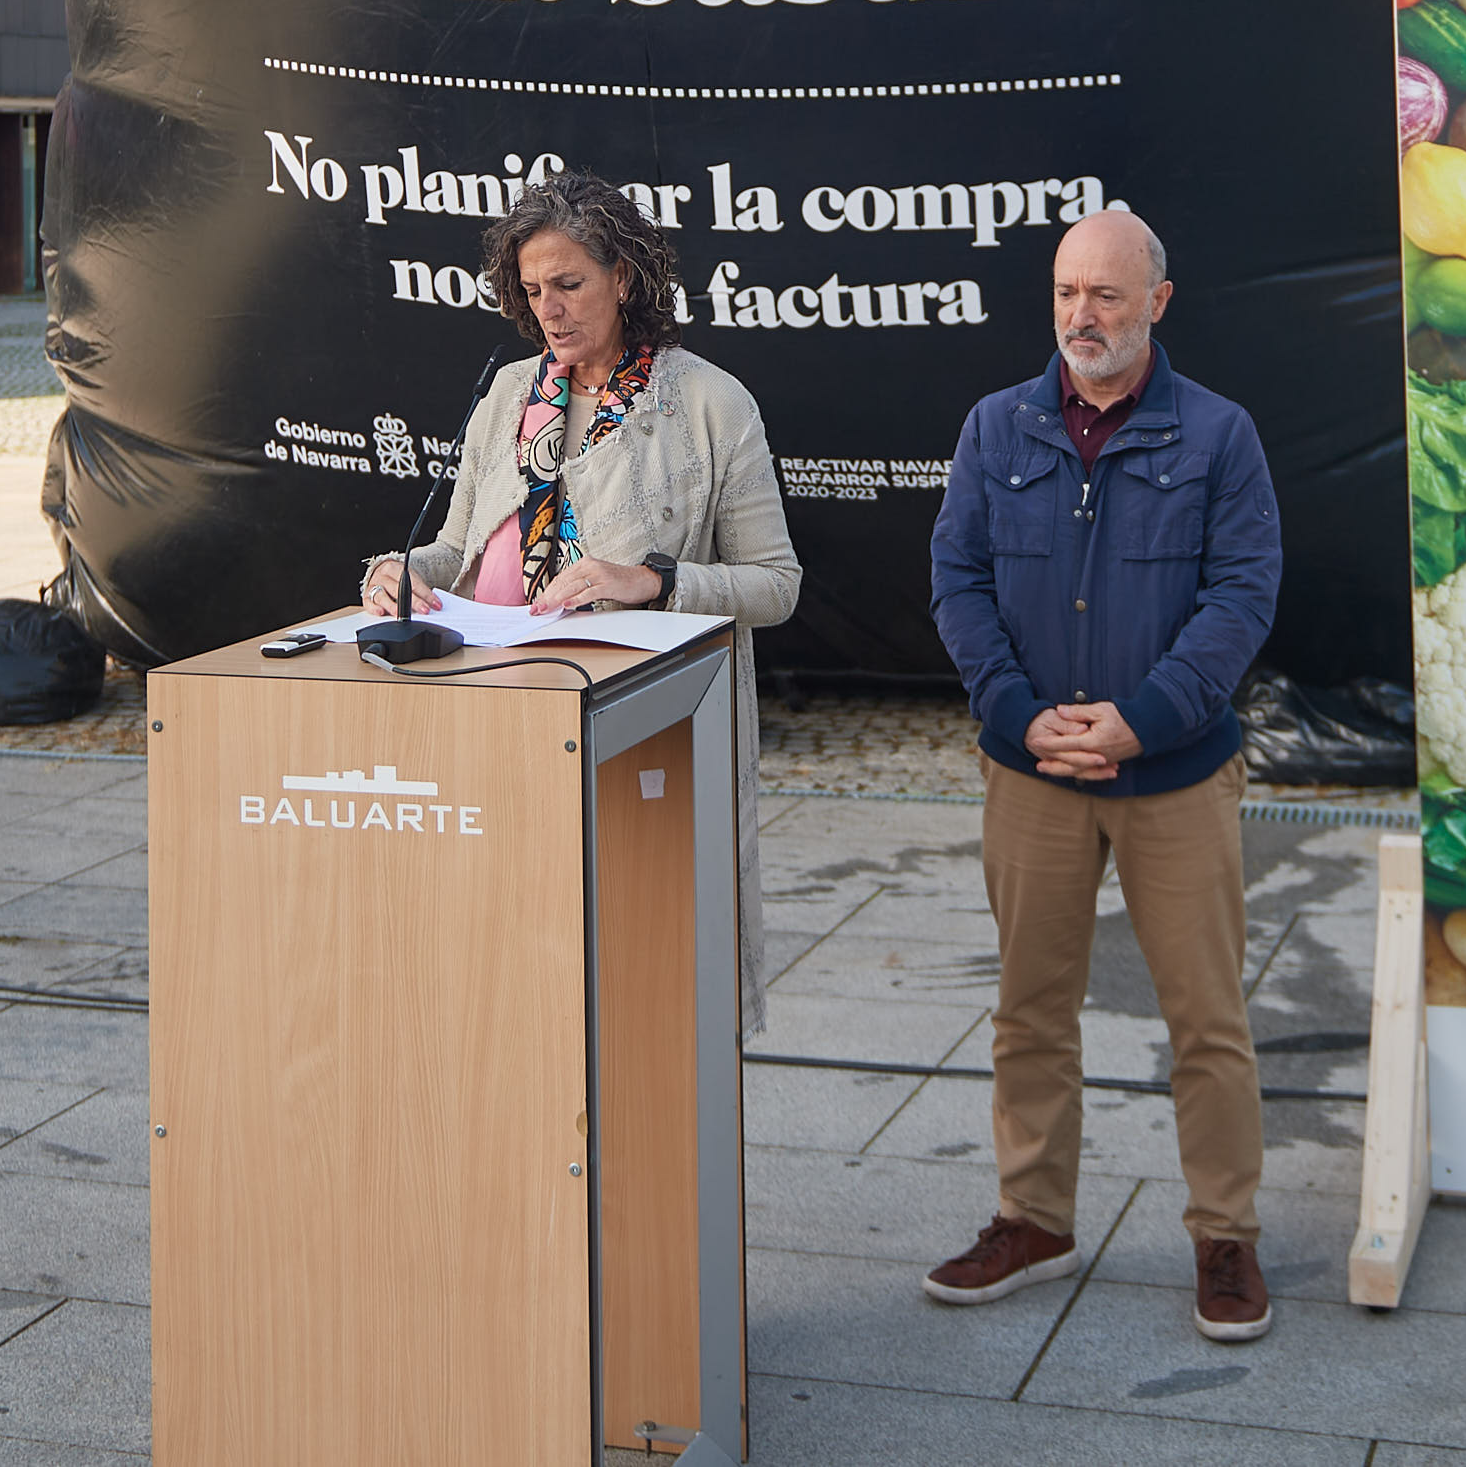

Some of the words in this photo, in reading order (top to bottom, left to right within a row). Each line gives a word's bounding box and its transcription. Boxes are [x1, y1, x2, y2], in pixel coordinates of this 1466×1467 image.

[264, 130, 348, 202] No
[707, 162, 784, 232] la
[707, 261, 989, 328] factura
[275, 417, 366, 448] Gobierno
[264, 440, 288, 461] de
[292, 445, 371, 473] Navarra
[780, 458, 885, 474] REACTIVAR
[783, 472, 889, 487] NAFARROA
[787, 484, 878, 500] 2020-2023
[240, 795, 483, 834] BALUARTE
